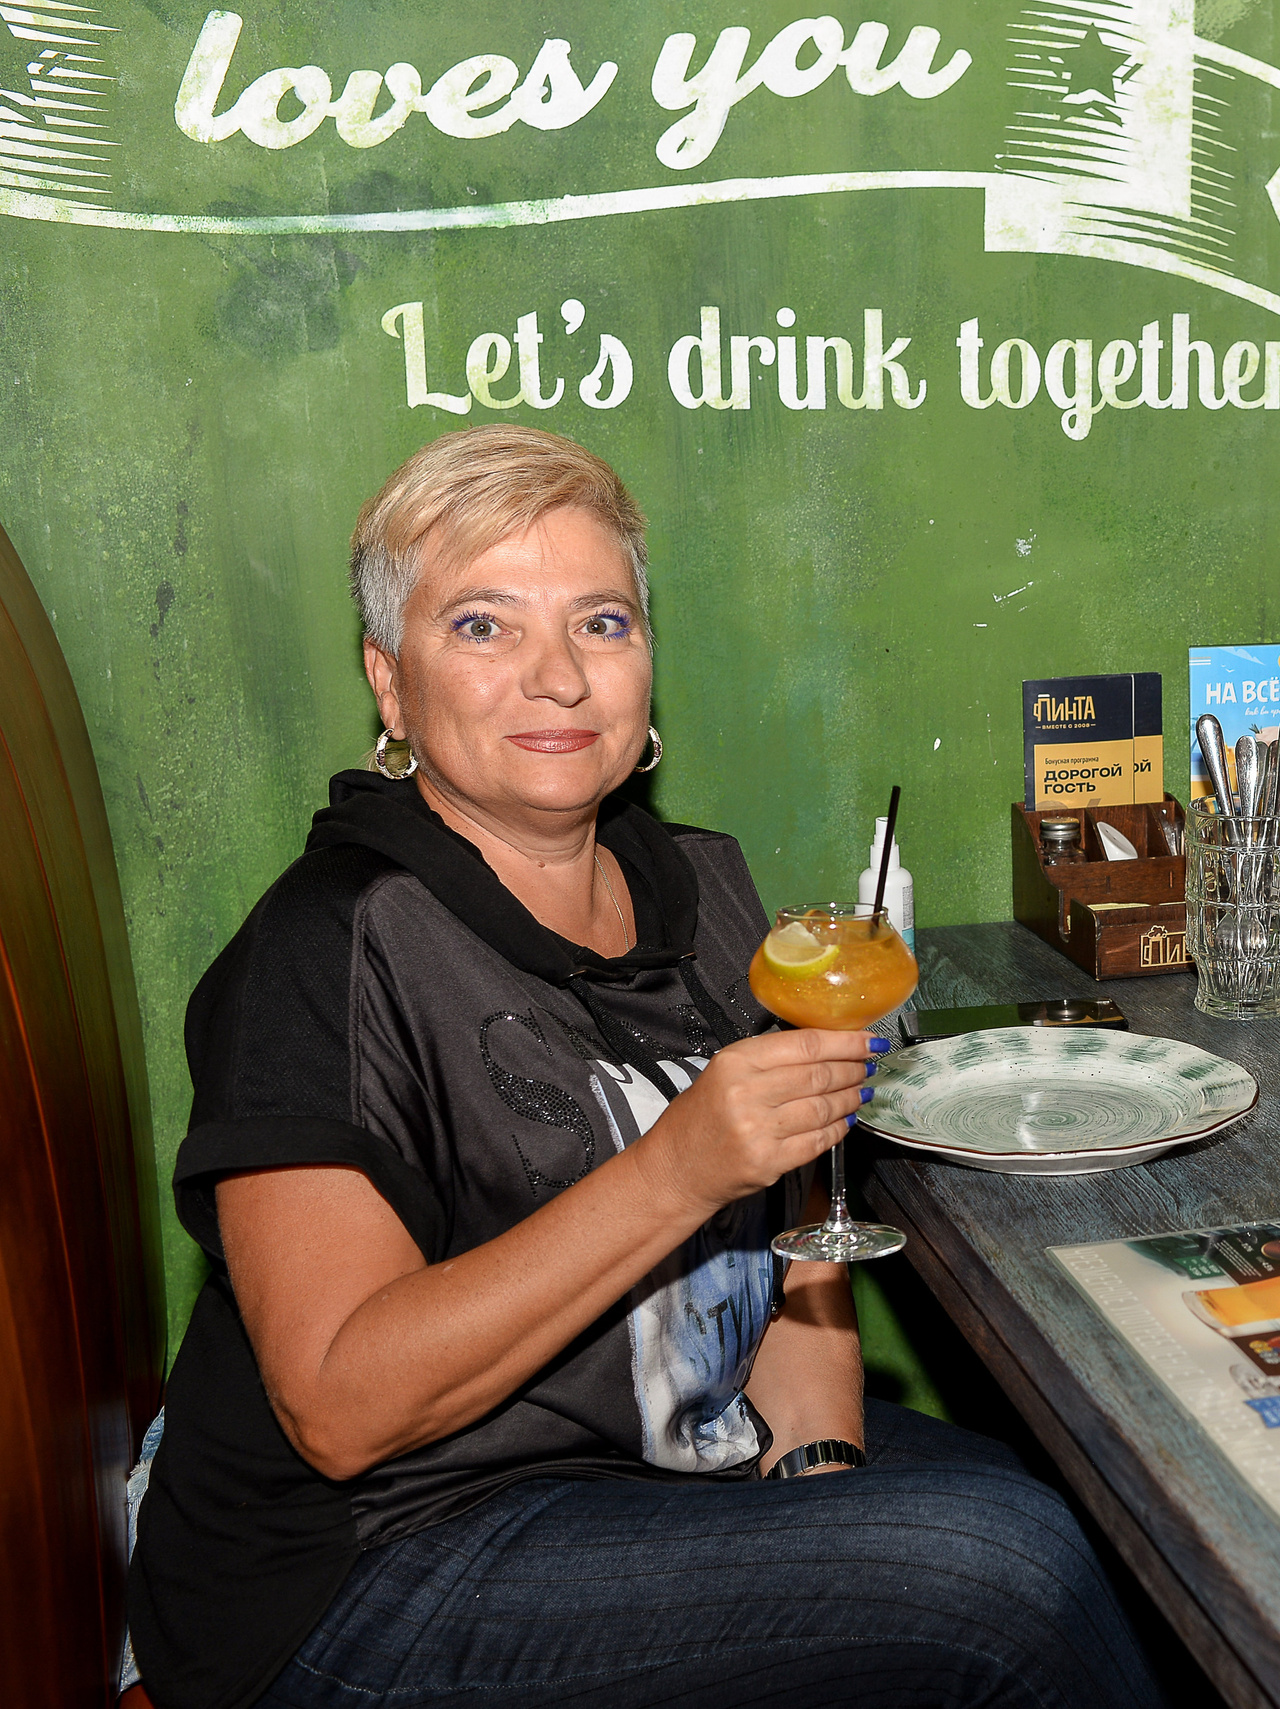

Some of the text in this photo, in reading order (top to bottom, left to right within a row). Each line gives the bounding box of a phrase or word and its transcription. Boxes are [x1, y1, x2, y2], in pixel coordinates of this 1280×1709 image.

[174, 10, 972, 170] loves you
[380, 299, 634, 415] Let's
[667, 305, 927, 411] drink
[1205, 681, 1238, 705] НА
[1242, 676, 1280, 704] ВСЁ
[1034, 695, 1096, 722] ПИНТА
[1043, 763, 1123, 782] ДОРОГОЙ
[1044, 782, 1097, 795] ГОСТЬ
